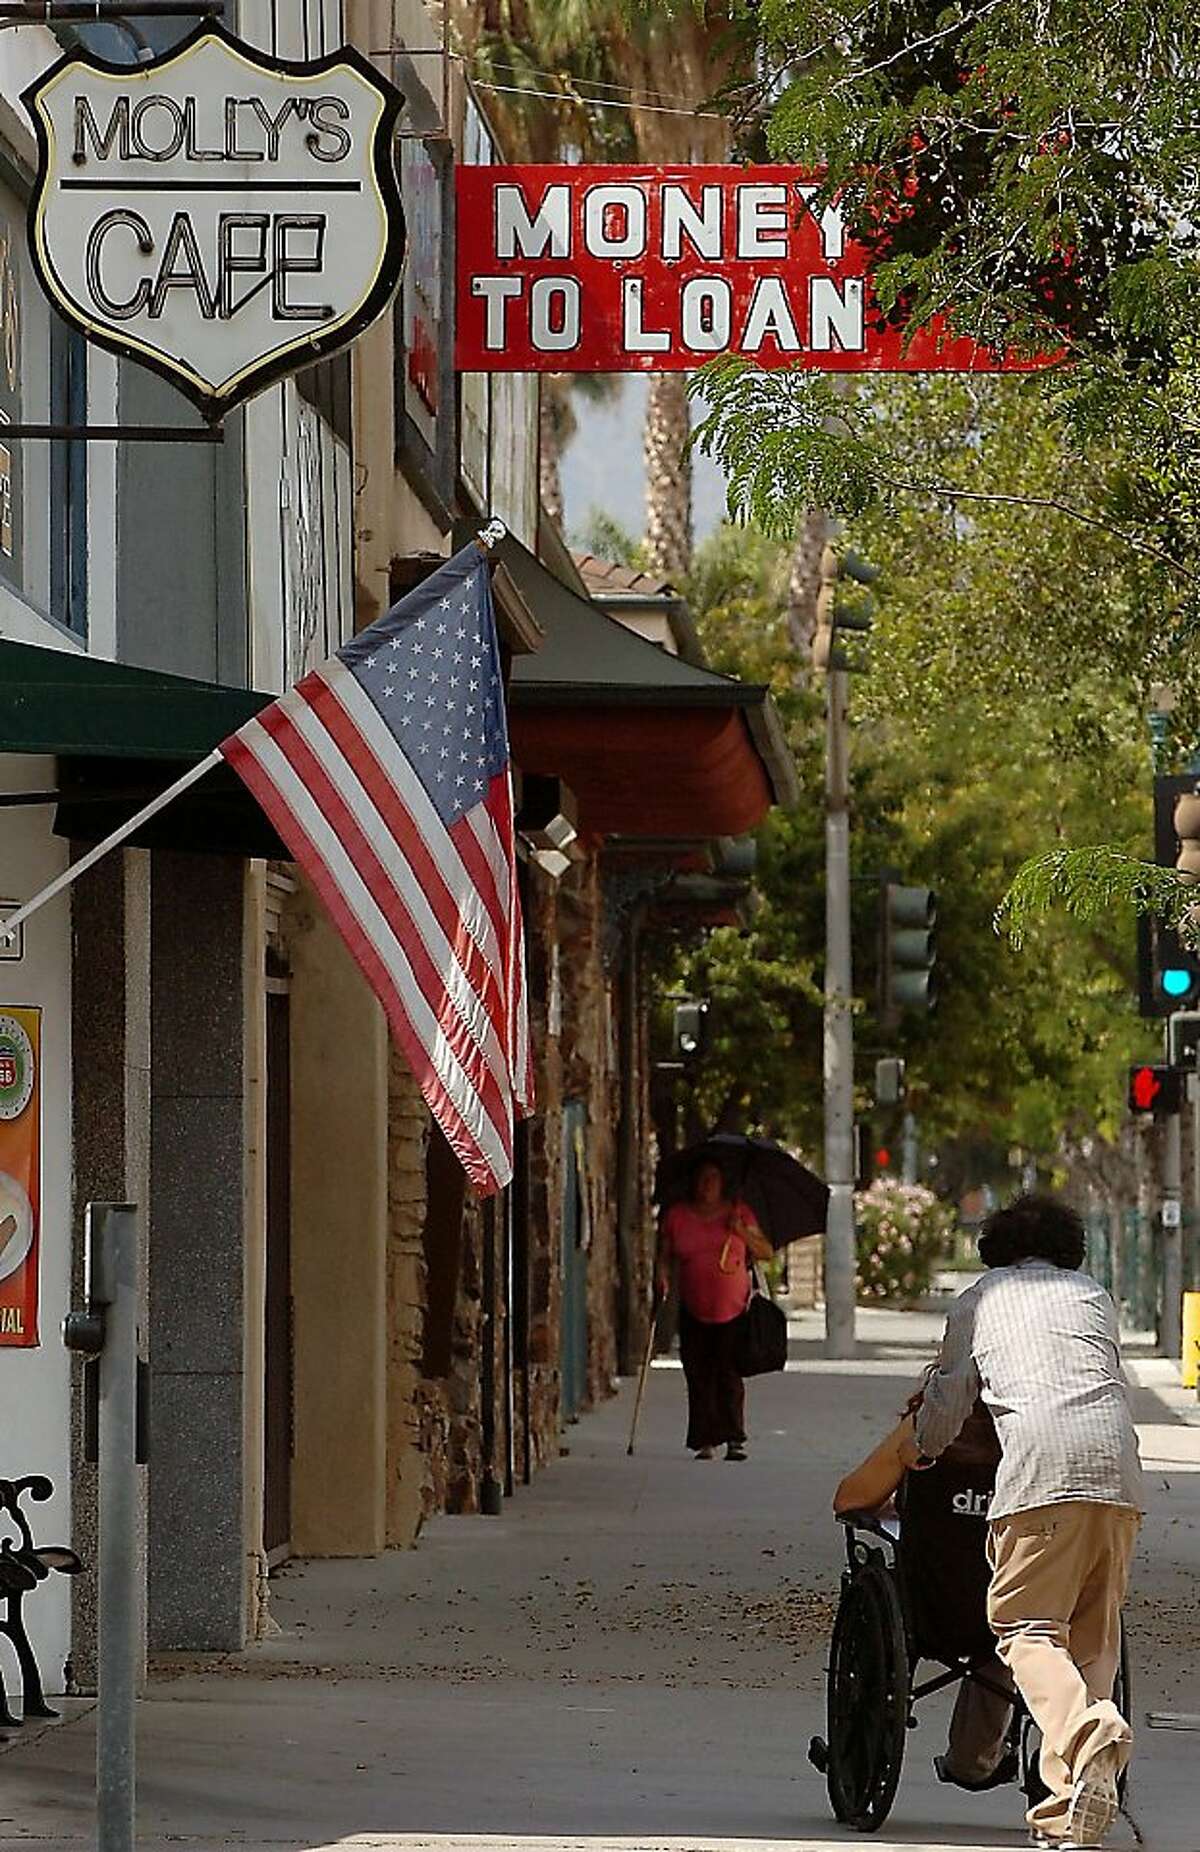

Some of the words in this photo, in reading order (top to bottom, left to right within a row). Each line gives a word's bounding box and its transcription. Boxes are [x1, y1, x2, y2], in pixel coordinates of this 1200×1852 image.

[73, 94, 351, 165] MOLLY'S
[495, 184, 848, 260] MONEY
[86, 208, 335, 321] CAFE
[471, 276, 581, 351] TO
[623, 276, 864, 352] LOAN
